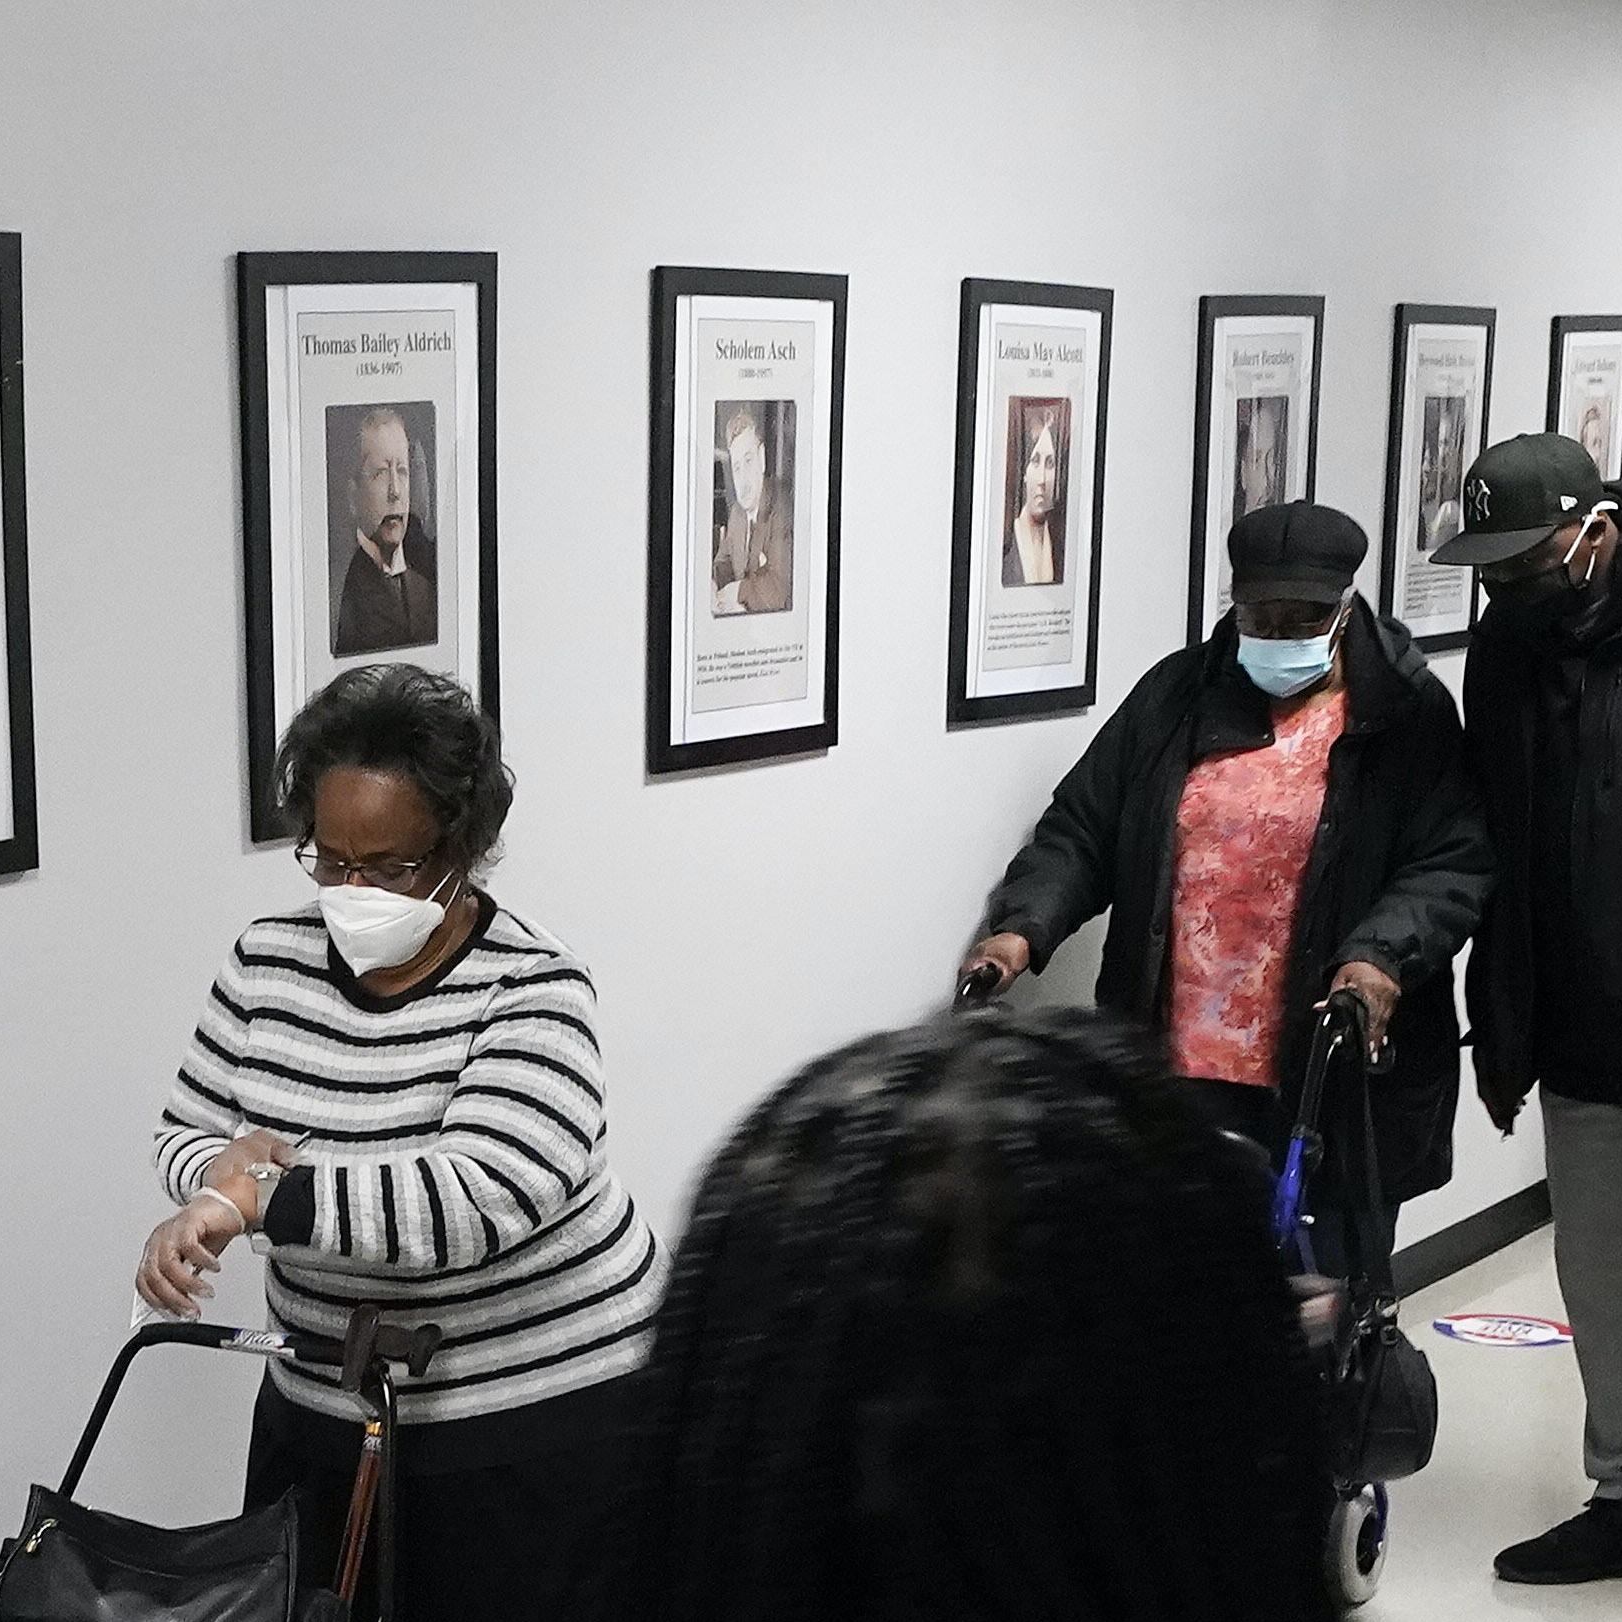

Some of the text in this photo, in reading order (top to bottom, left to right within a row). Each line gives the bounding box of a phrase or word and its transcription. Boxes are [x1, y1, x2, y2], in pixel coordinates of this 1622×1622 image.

[301, 330, 452, 358] Thomas Bailey Aldrich
[714, 338, 796, 361] Scholem Asch
[998, 339, 1030, 361] Louisa
[1034, 341, 1053, 366] May
